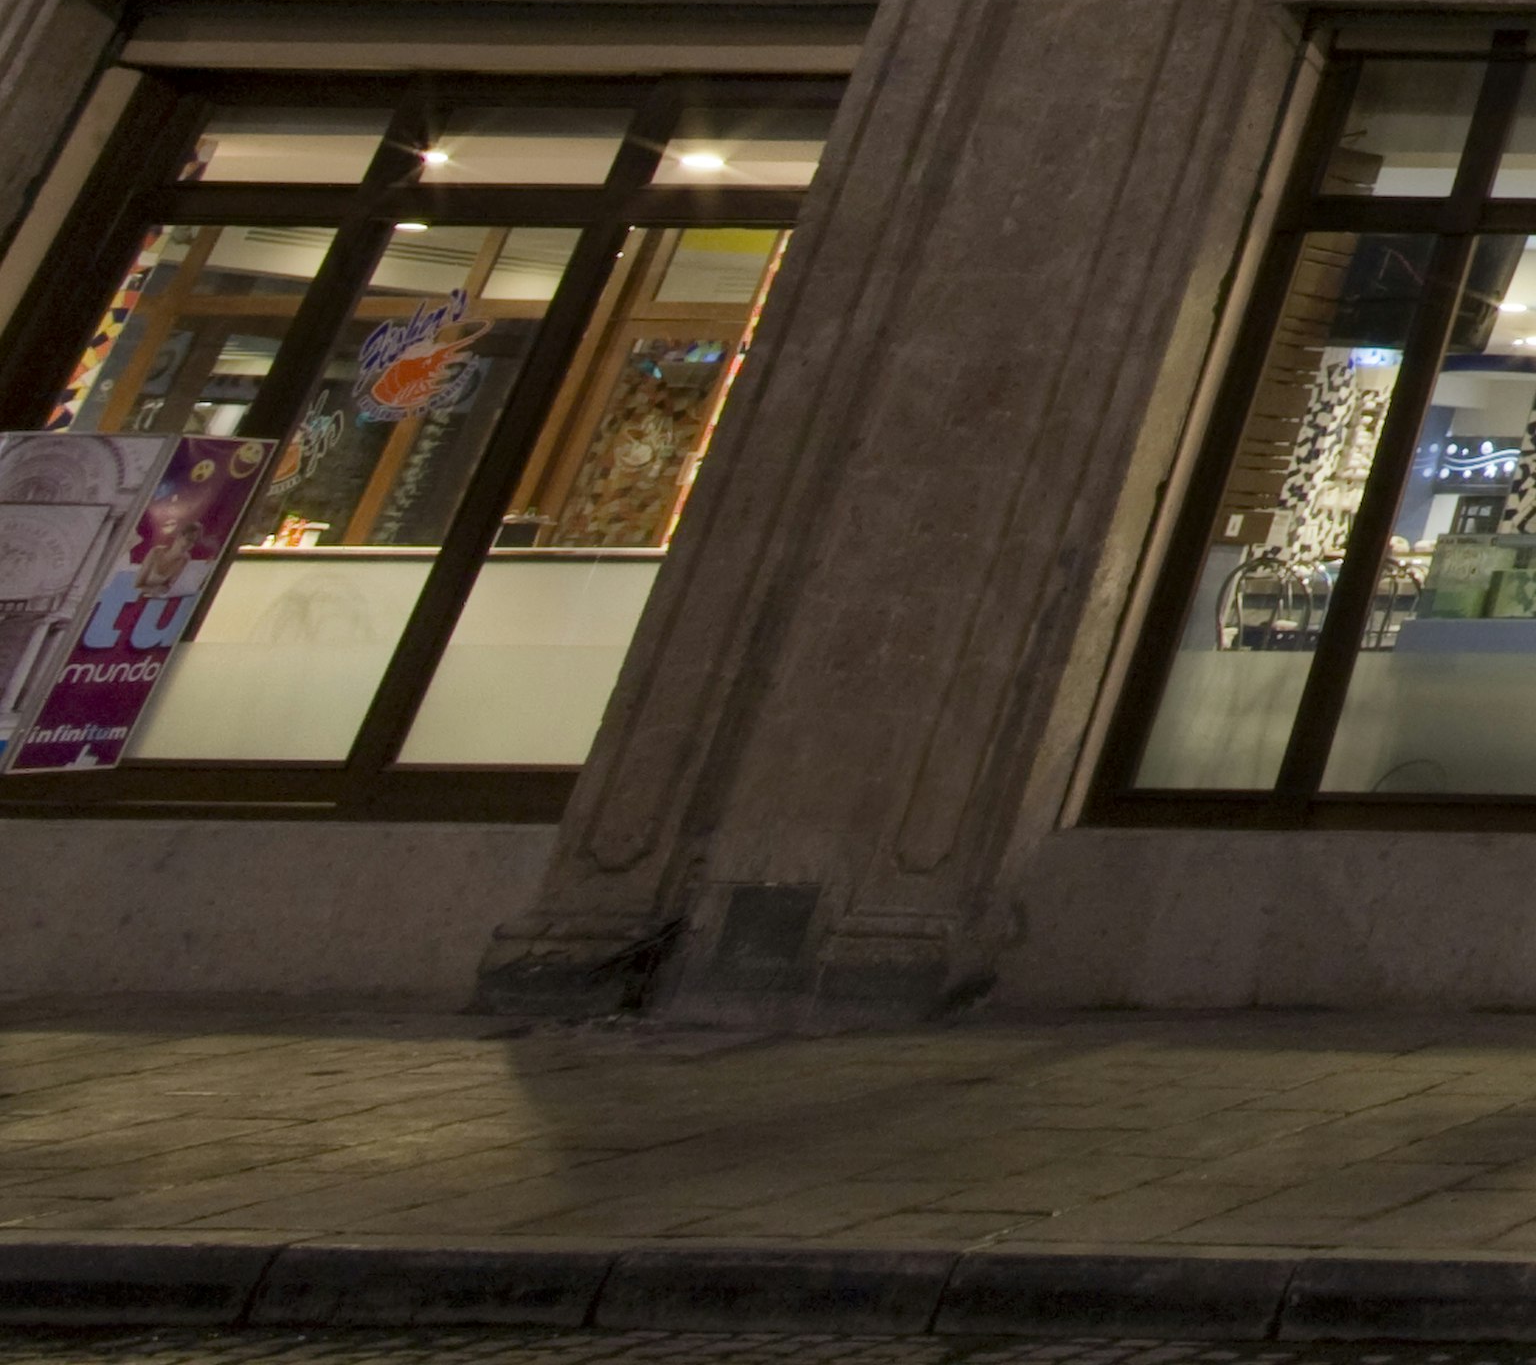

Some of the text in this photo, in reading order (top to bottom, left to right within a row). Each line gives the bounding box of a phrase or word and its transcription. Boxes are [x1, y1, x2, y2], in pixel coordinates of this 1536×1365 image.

[353, 289, 467, 396] Fisher's
[83, 571, 200, 649] tu
[58, 655, 163, 684] mundo
[27, 722, 129, 743] infinitum
